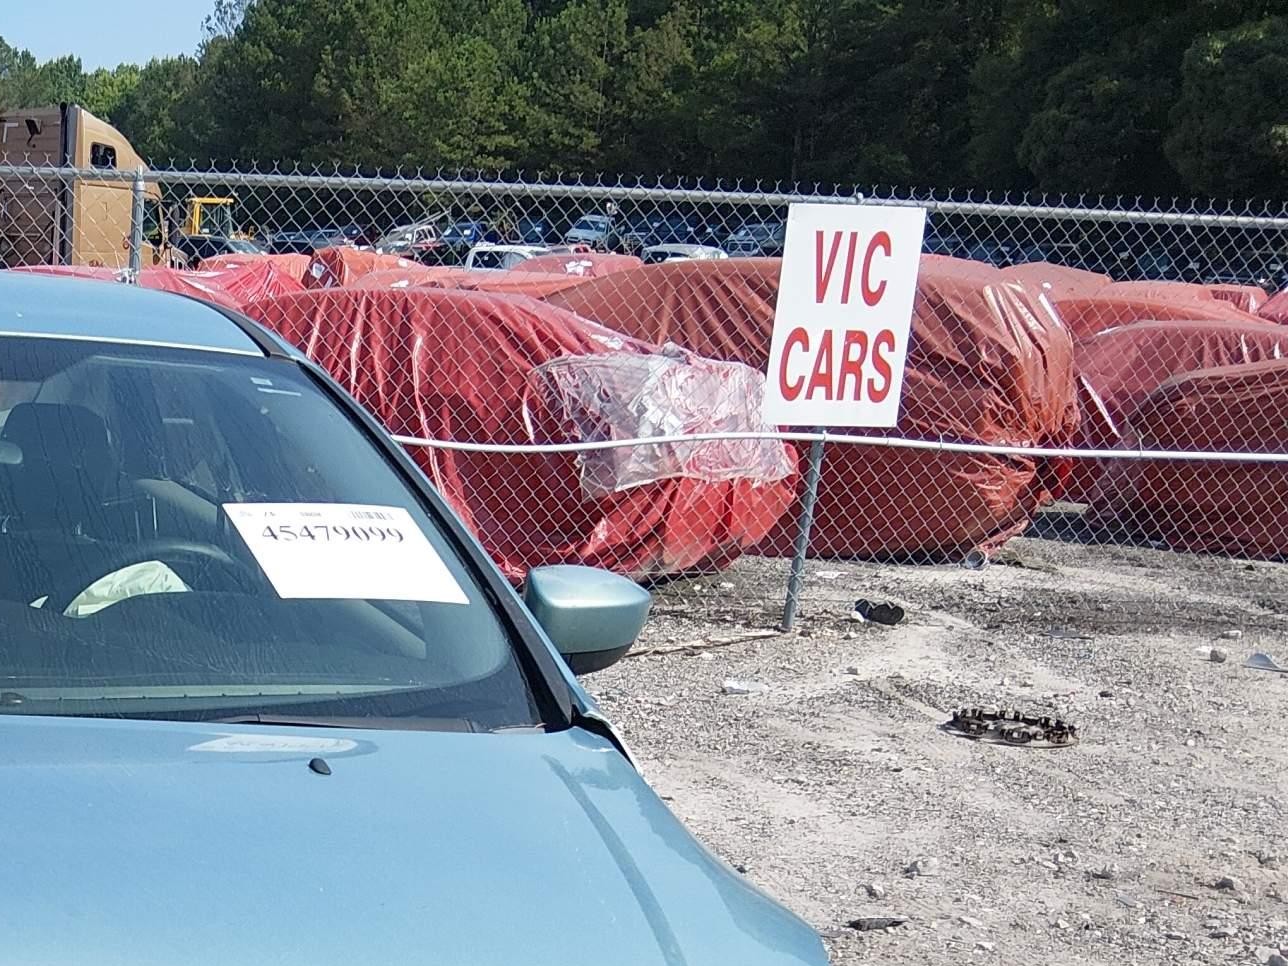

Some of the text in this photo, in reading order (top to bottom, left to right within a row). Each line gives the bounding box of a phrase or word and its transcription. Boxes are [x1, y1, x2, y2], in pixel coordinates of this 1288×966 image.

[815, 230, 892, 307] VIC
[778, 326, 896, 403] CARS
[261, 524, 405, 543] 45479099
